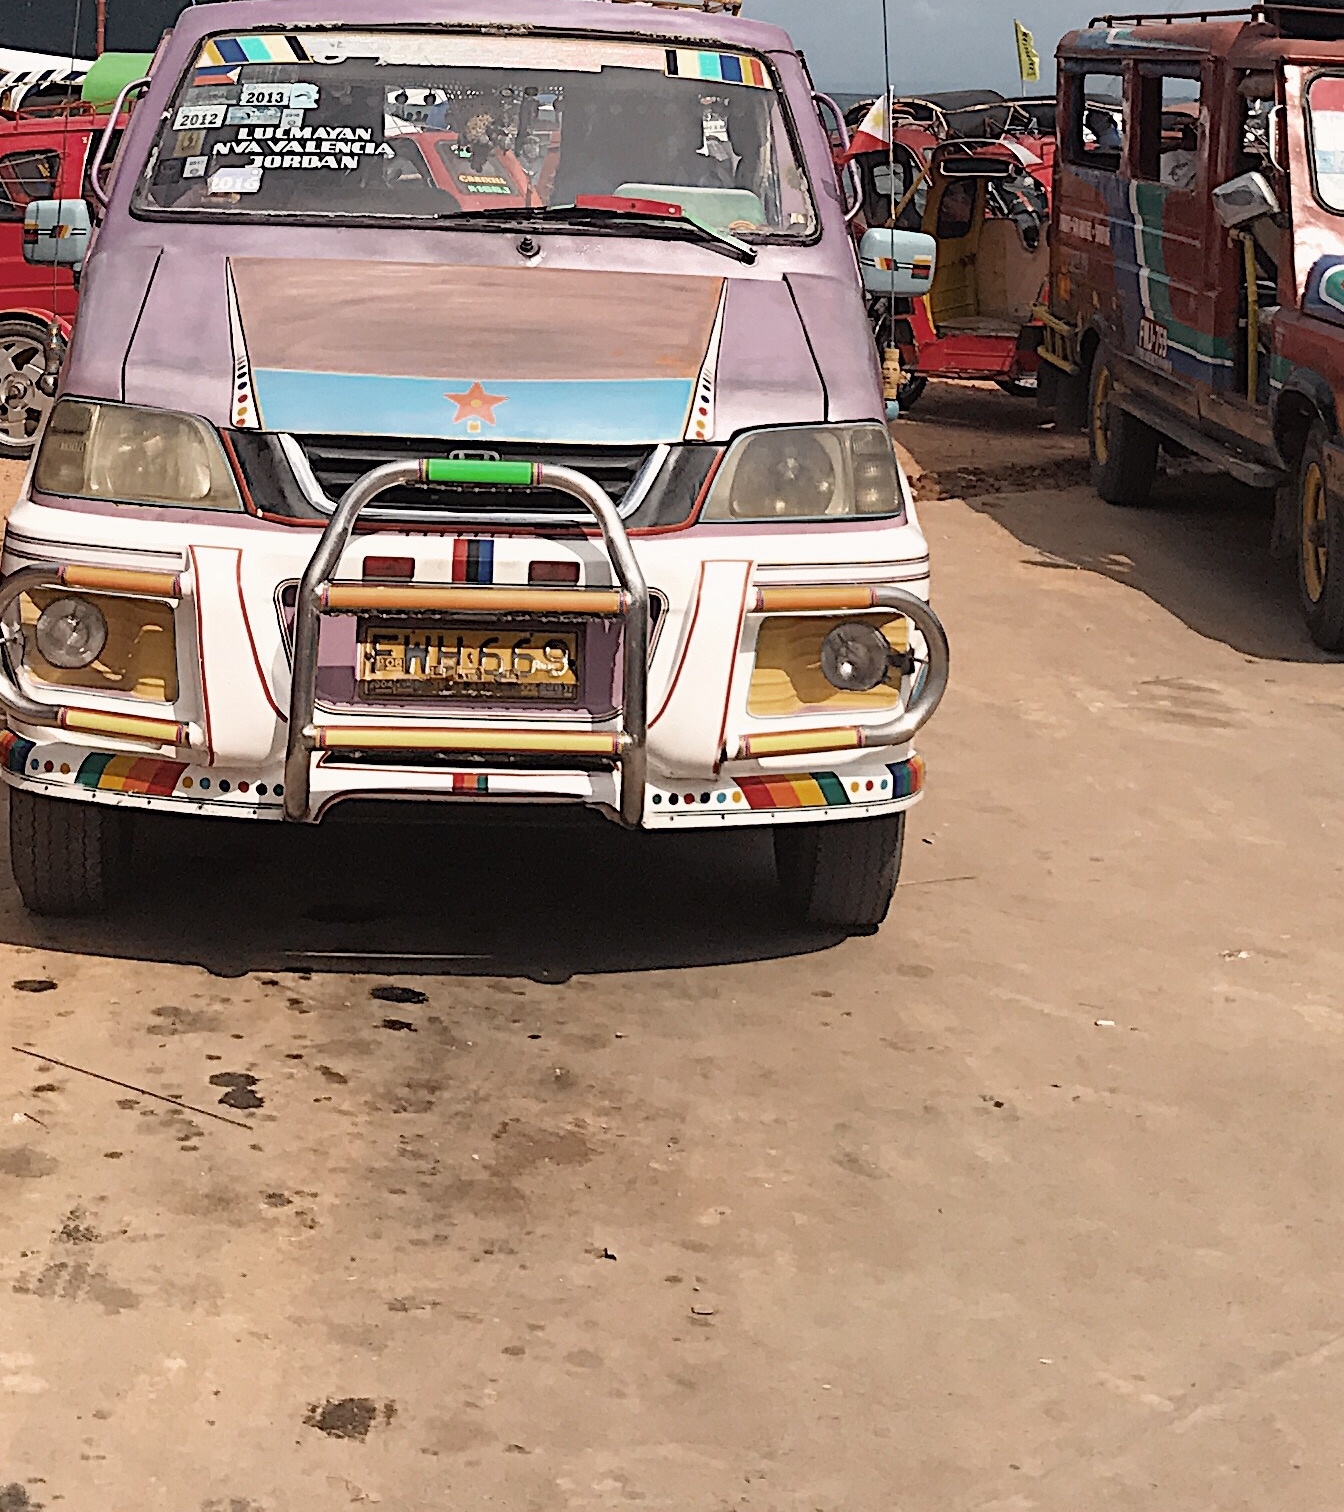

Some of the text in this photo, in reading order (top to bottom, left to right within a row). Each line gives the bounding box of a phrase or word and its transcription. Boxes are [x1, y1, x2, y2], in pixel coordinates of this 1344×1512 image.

[245, 90, 284, 105] 2013
[179, 113, 218, 127] 2012
[237, 127, 372, 141] LUCMAYAN
[212, 141, 396, 159] NVA VALENCIA
[244, 155, 359, 169] JORDAN
[479, 636, 570, 679] 669
